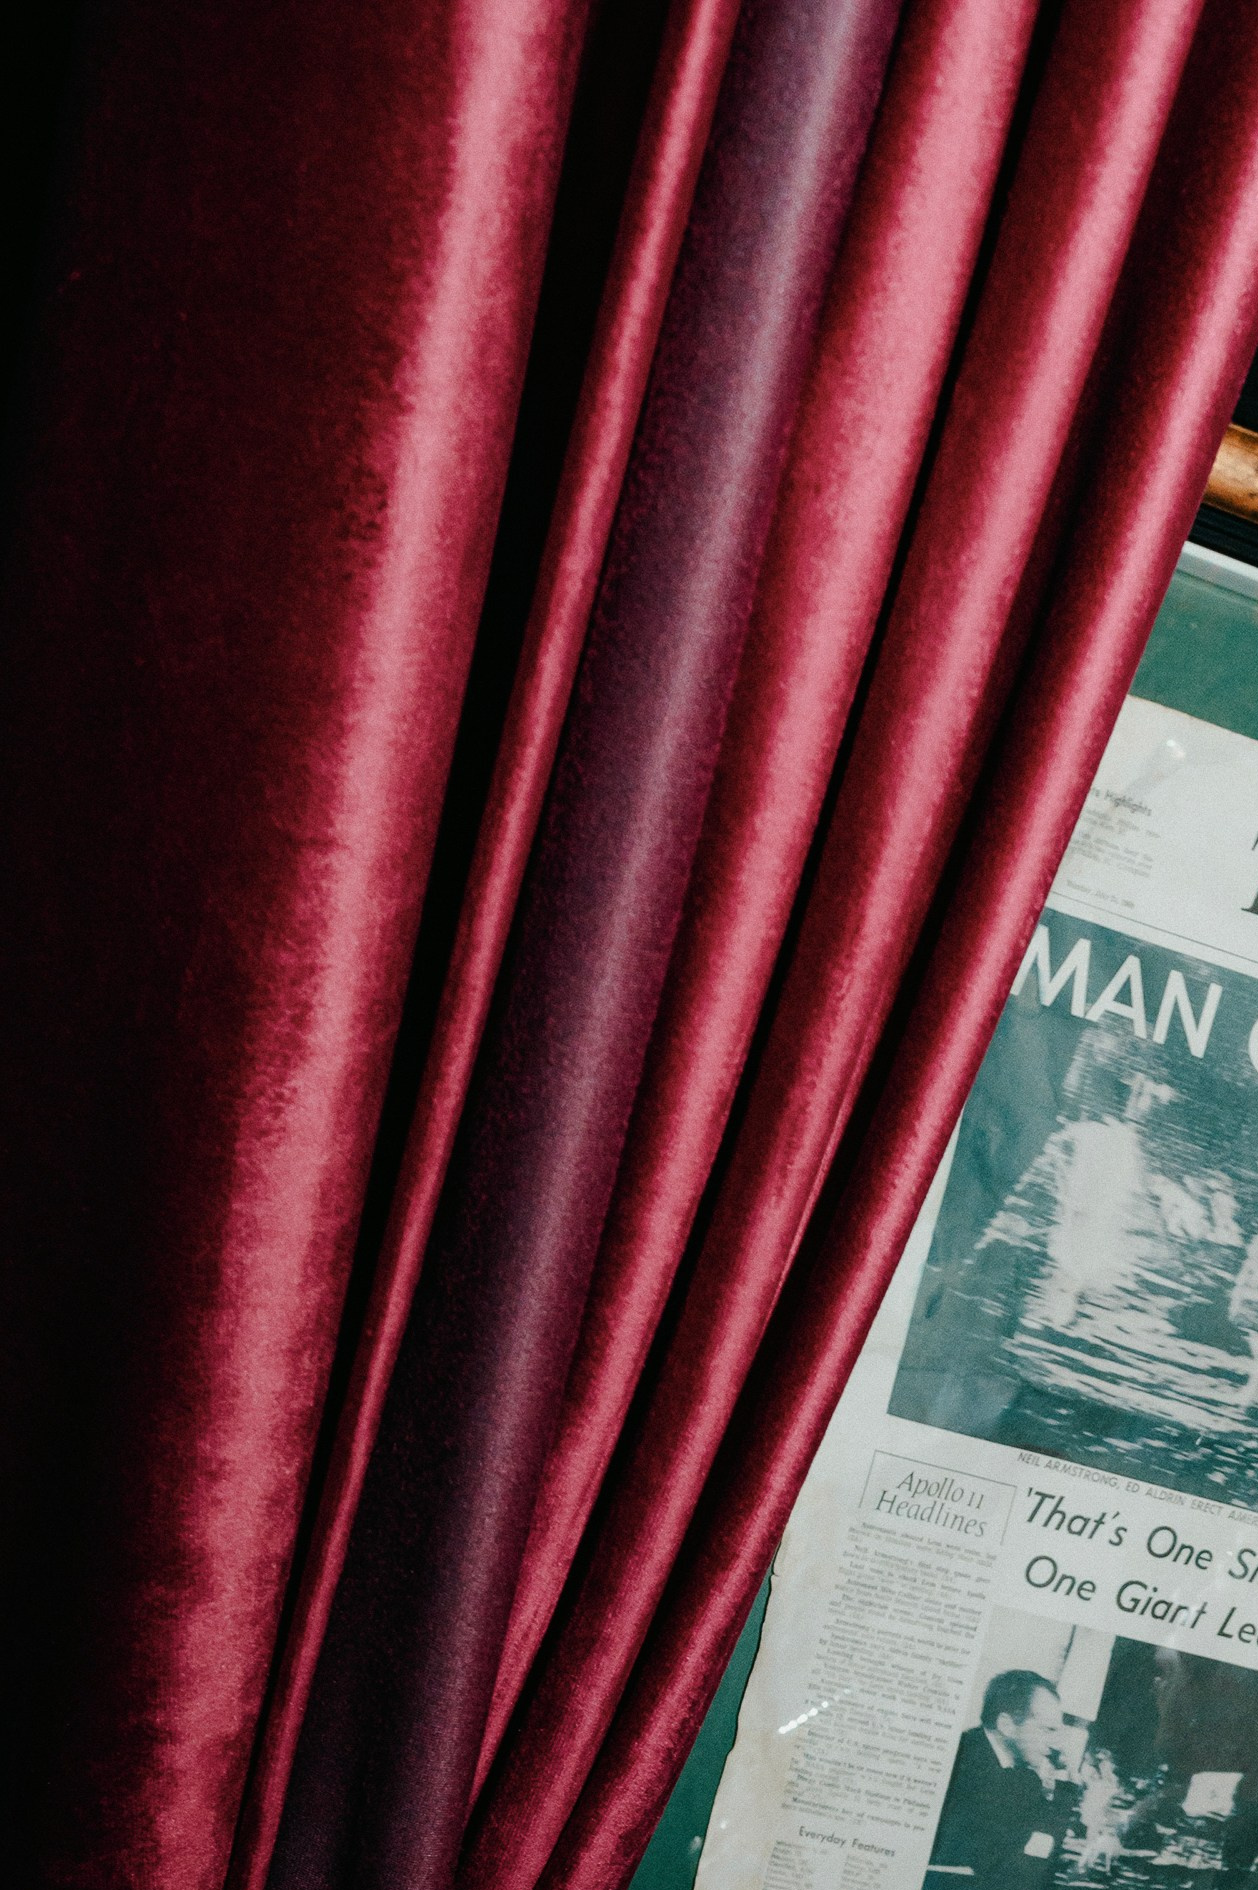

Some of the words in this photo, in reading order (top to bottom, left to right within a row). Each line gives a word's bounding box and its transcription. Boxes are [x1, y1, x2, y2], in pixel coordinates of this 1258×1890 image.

[1010, 923, 1223, 1059] MAN
[895, 1470, 965, 1507] Apollo
[1016, 1451, 1040, 1467] NEIL
[1042, 1458, 1120, 1490] ARMSTRONG,
[1124, 1480, 1141, 1494] ED
[1189, 1498, 1224, 1515] ERECT
[874, 1488, 987, 1537] Headlines
[1145, 1525, 1214, 1571] One
[1024, 1554, 1097, 1602] One
[1115, 1579, 1208, 1629] Giant
[797, 1824, 847, 1848] Everyday
[850, 1837, 896, 1858] Features
